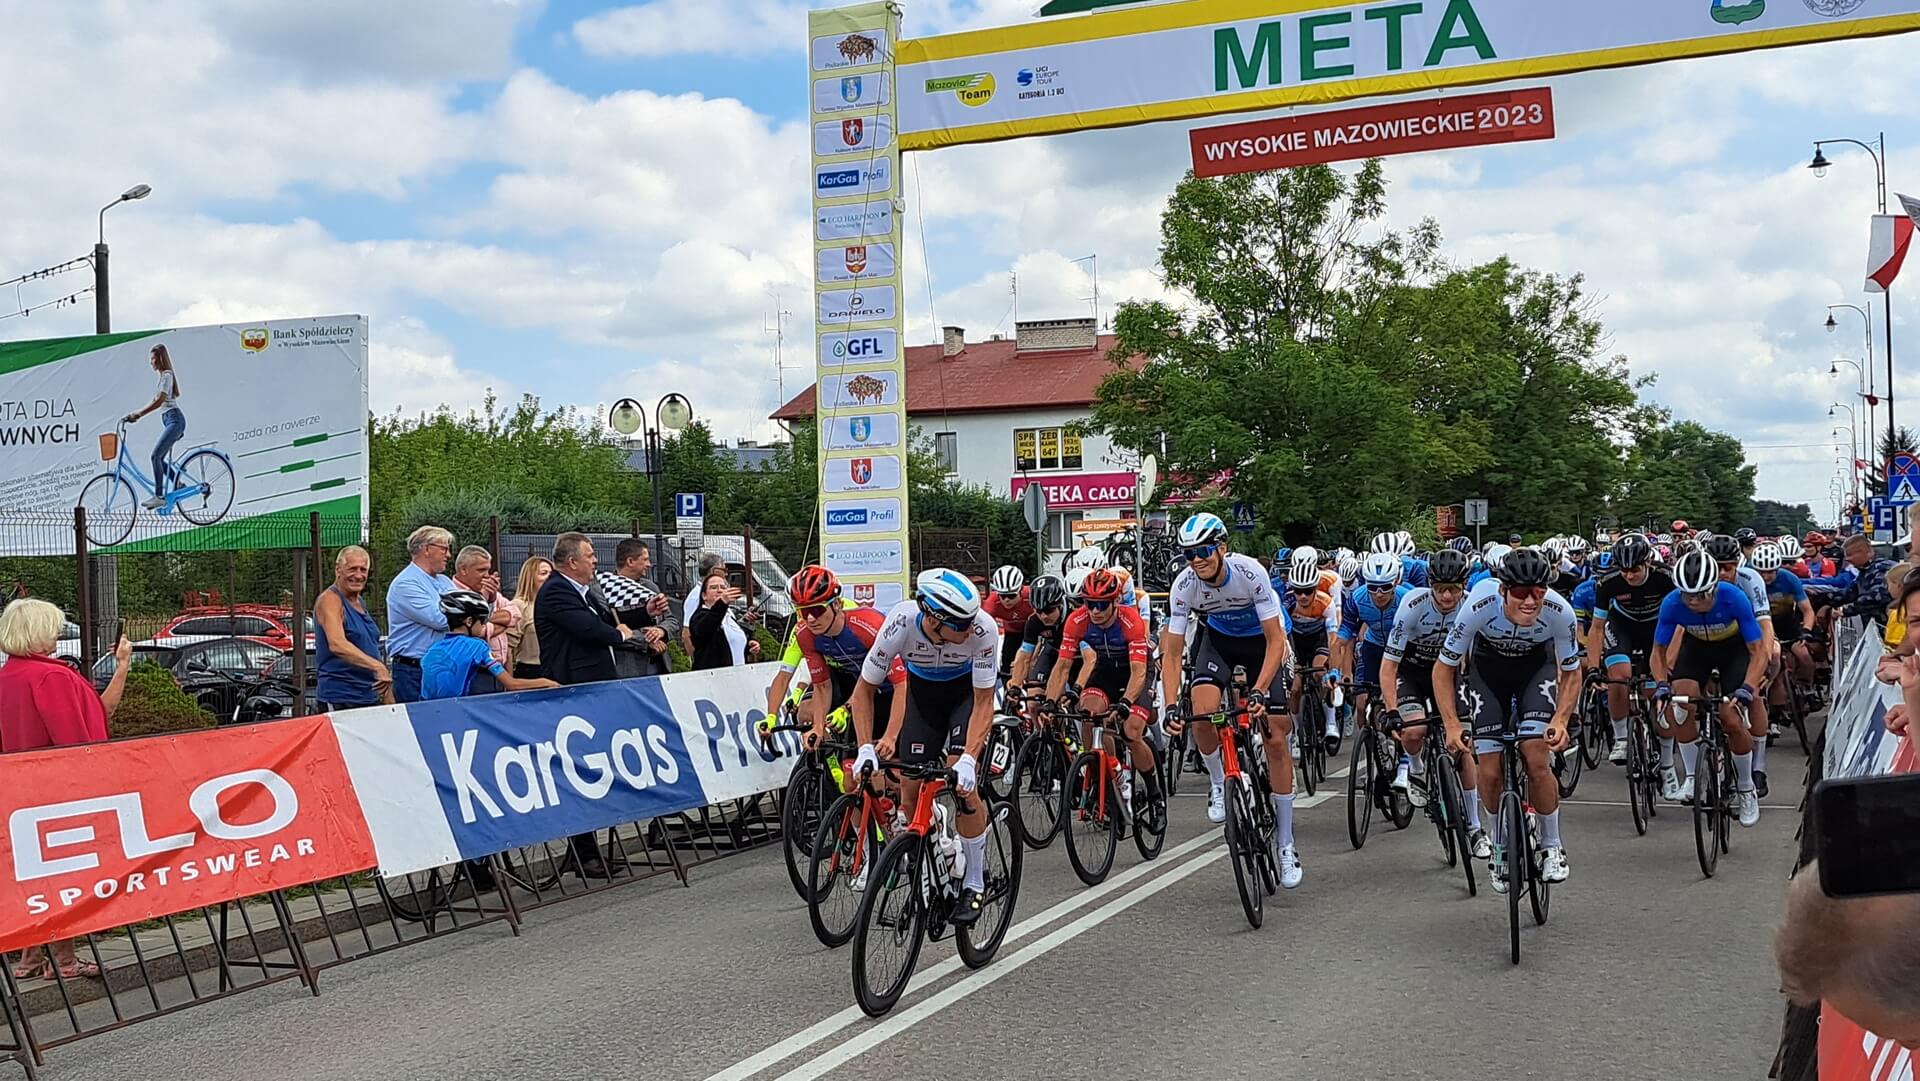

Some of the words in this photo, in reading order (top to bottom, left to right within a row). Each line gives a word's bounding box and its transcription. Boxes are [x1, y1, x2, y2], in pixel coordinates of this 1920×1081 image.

[1214, 0, 1497, 92] META
[1035, 70, 1060, 79] EUROPE
[927, 79, 966, 91] Mazovia
[959, 88, 991, 100] Team
[1204, 131, 1308, 162] WYSOKIE
[1313, 112, 1475, 149] MAZOWIECKIE
[1478, 104, 1543, 129] 2023
[820, 173, 857, 185] KarGas
[827, 215, 843, 223] ECO
[828, 308, 886, 318] DANIELO
[273, 329, 297, 340] Bank
[847, 338, 883, 356] GFL
[0, 401, 28, 420] TA
[34, 398, 76, 419] DLA
[0, 423, 80, 447] WNYCH
[232, 428, 263, 441] Jazda
[264, 425, 279, 435] na
[280, 415, 321, 431] rowerze
[1064, 446, 1080, 454] 225
[1014, 485, 1083, 502] ATEKA
[682, 495, 697, 516] P
[828, 511, 865, 523] KarGas
[870, 509, 894, 521] Profil
[1880, 507, 1893, 527] P
[852, 550, 889, 559] HARPOON
[440, 715, 680, 825] KarGas
[693, 686, 802, 773] Pro
[993, 745, 1006, 766] 22
[9, 768, 299, 882] ELO
[26, 838, 315, 915] SPORTSWEAR
